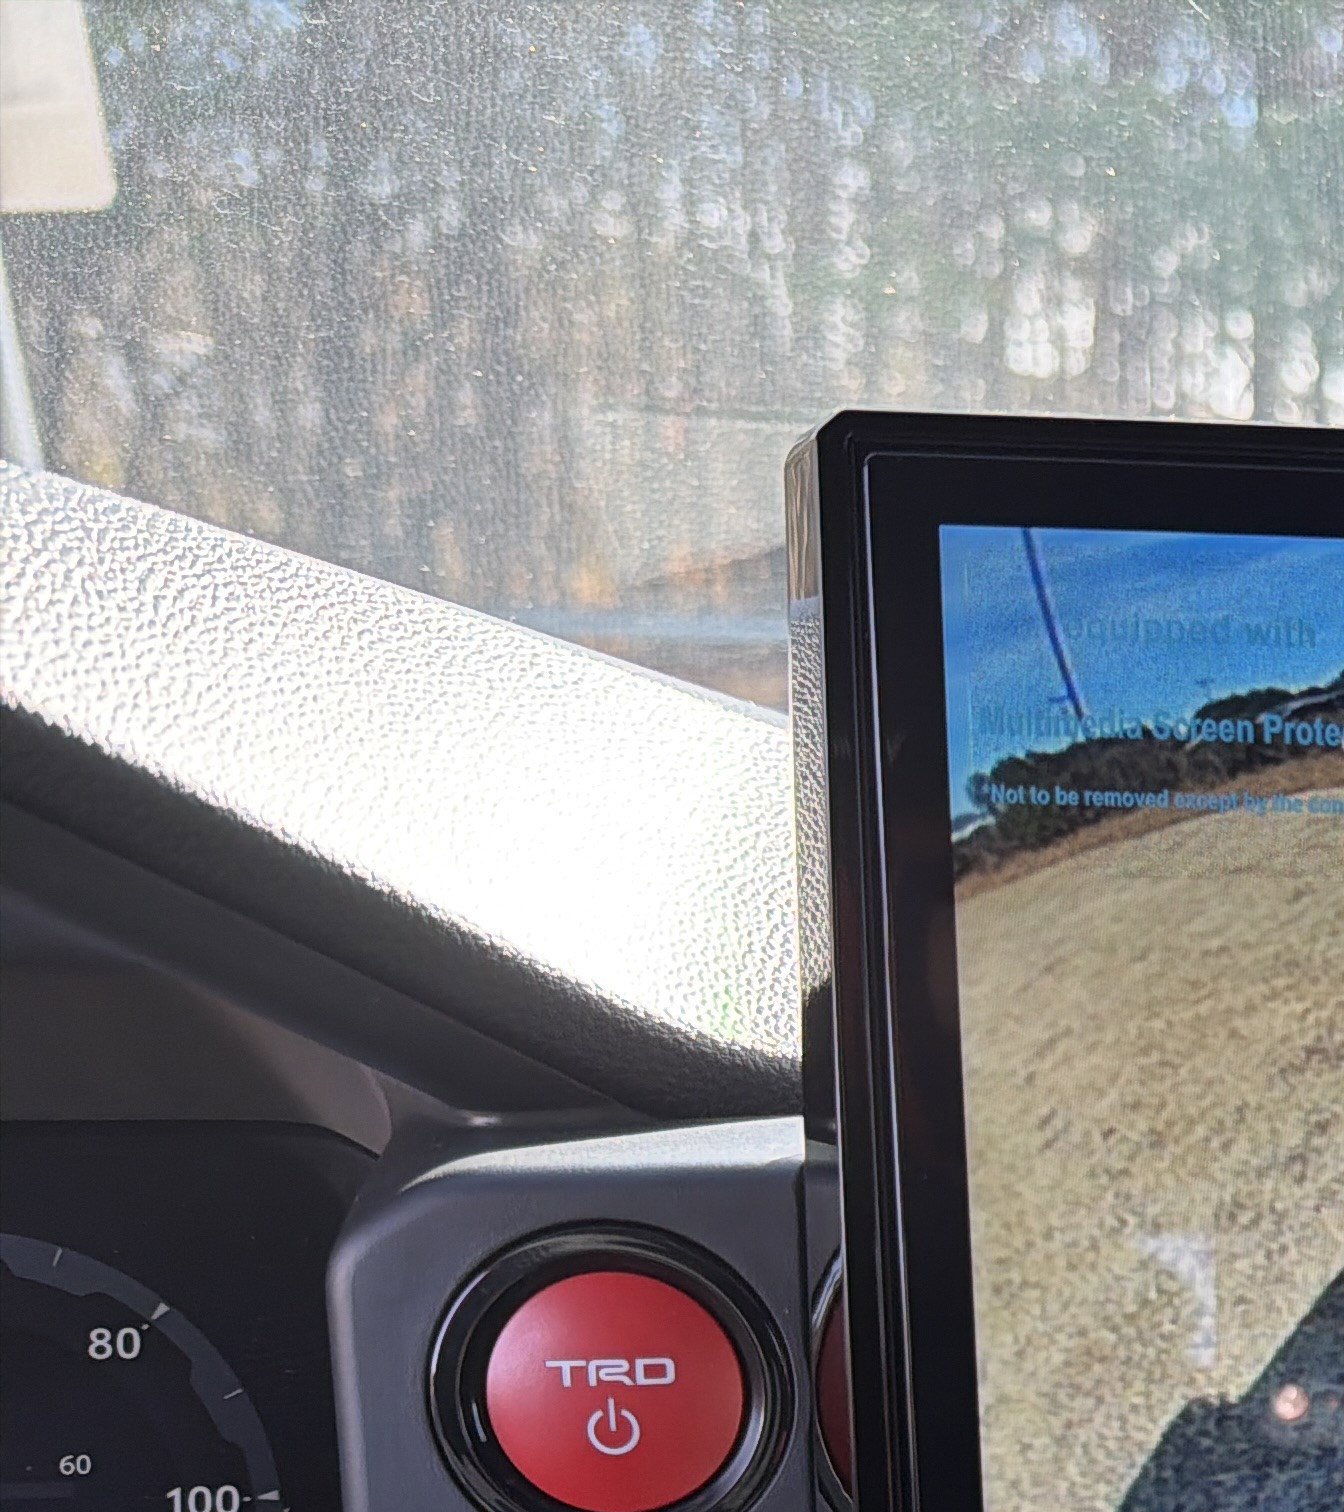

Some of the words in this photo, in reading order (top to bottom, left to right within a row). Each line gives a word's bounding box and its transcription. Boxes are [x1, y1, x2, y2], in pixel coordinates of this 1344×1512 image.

[1247, 614, 1317, 648] with
[1151, 709, 1255, 744] Screen
[1029, 785, 1050, 805] to
[1055, 786, 1080, 806] be
[1083, 789, 1169, 808] removed
[88, 1327, 141, 1360] 80
[545, 1358, 676, 1387] TRD
[59, 1454, 92, 1476] 60
